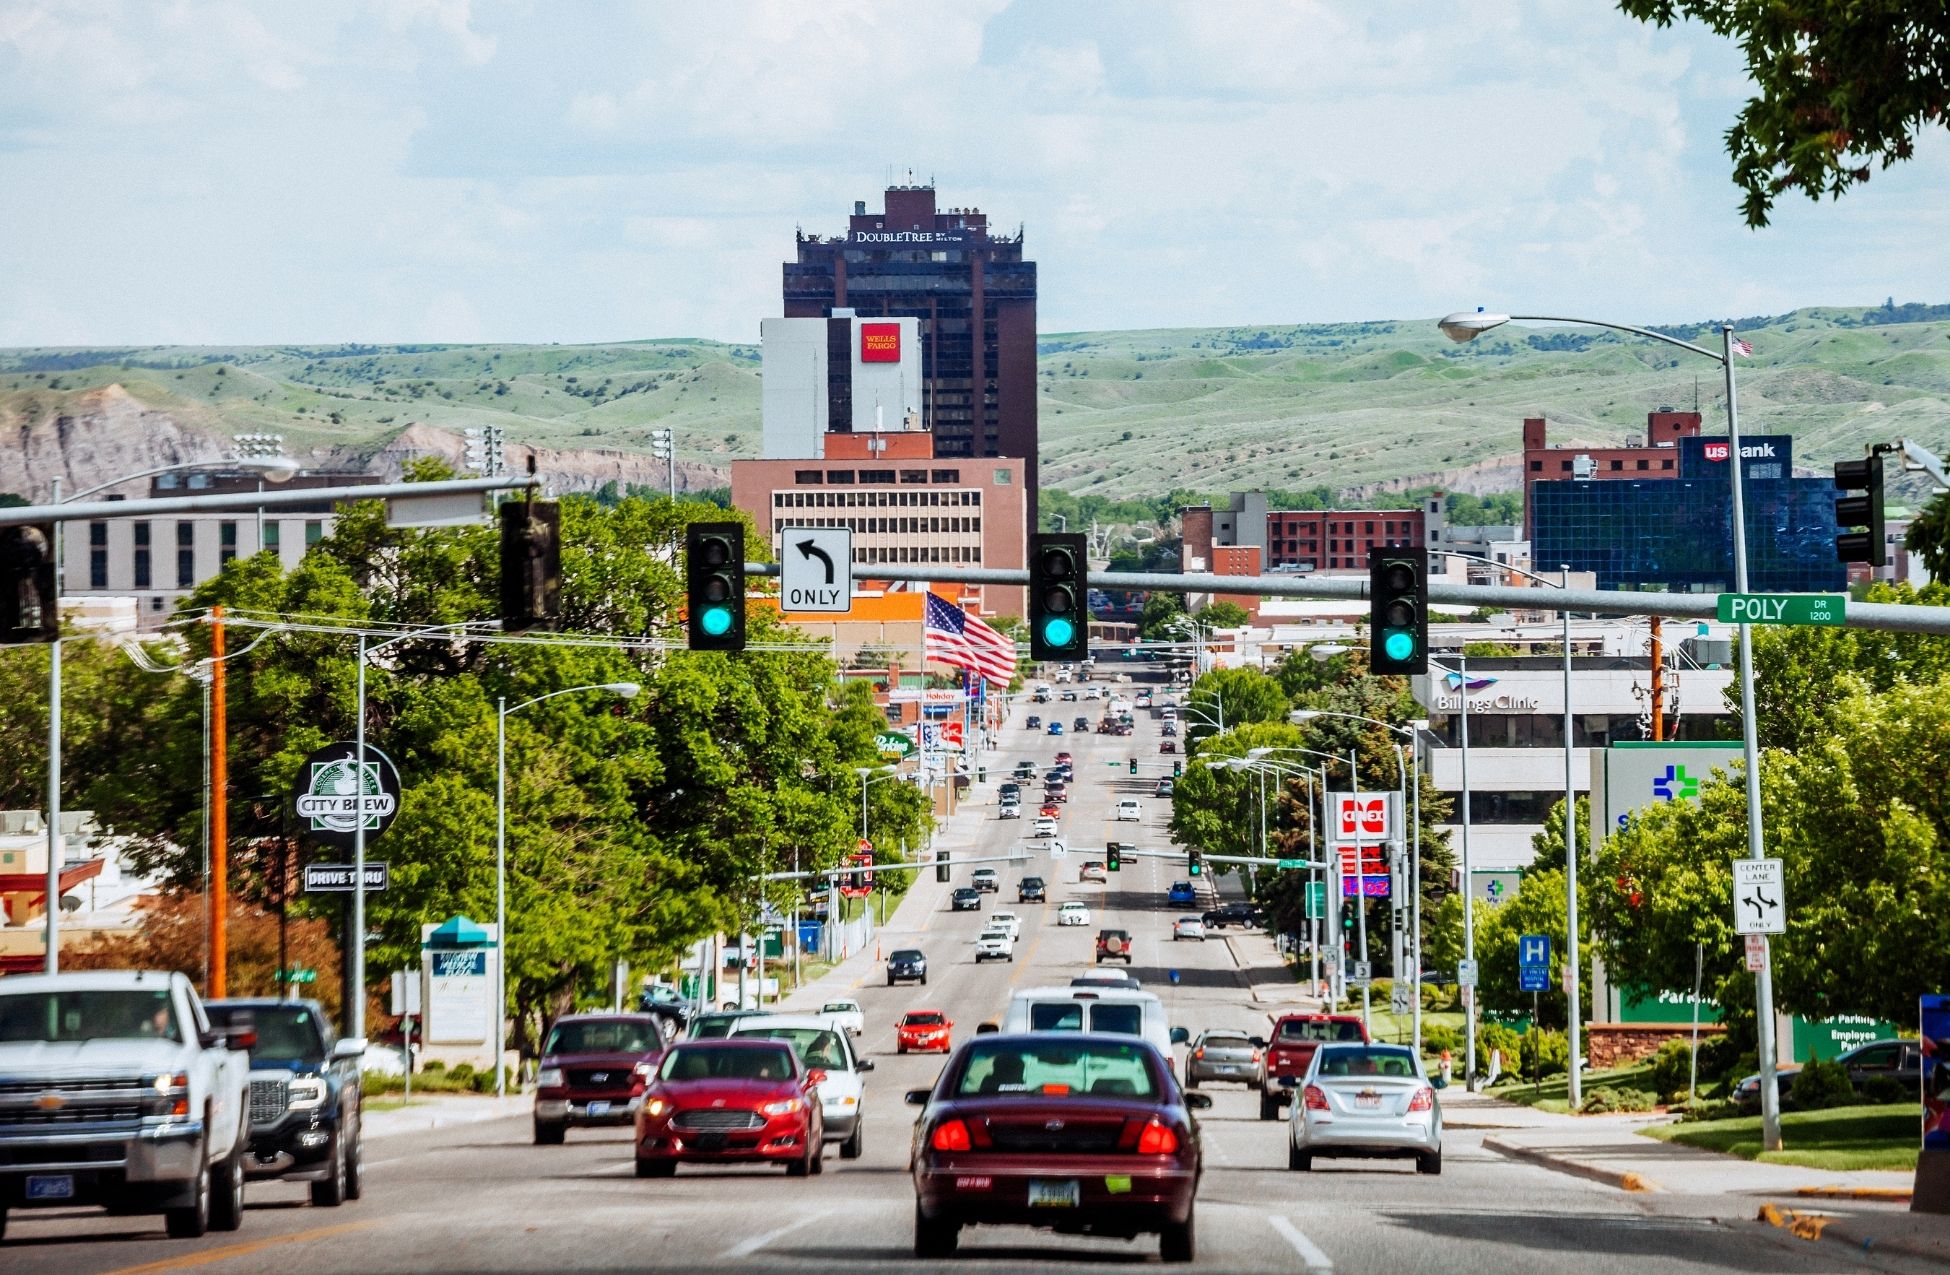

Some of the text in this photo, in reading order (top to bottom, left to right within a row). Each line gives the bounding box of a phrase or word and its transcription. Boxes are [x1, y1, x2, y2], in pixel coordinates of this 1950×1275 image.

[865, 335, 897, 343] WELLS
[866, 342, 897, 350] FARGO
[790, 588, 841, 605] ONLY
[1731, 599, 1827, 619] POLY DR
[1810, 611, 1832, 621] 1200
[1437, 694, 1539, 713] Billngs Clinic
[301, 799, 336, 811] CITY
[1740, 864, 1776, 872] CENTER
[308, 870, 384, 885] DRIVE TRU
[1526, 940, 1544, 962] H
[1839, 1014, 1876, 1026] Parking
[1831, 1029, 1877, 1042] Employee
